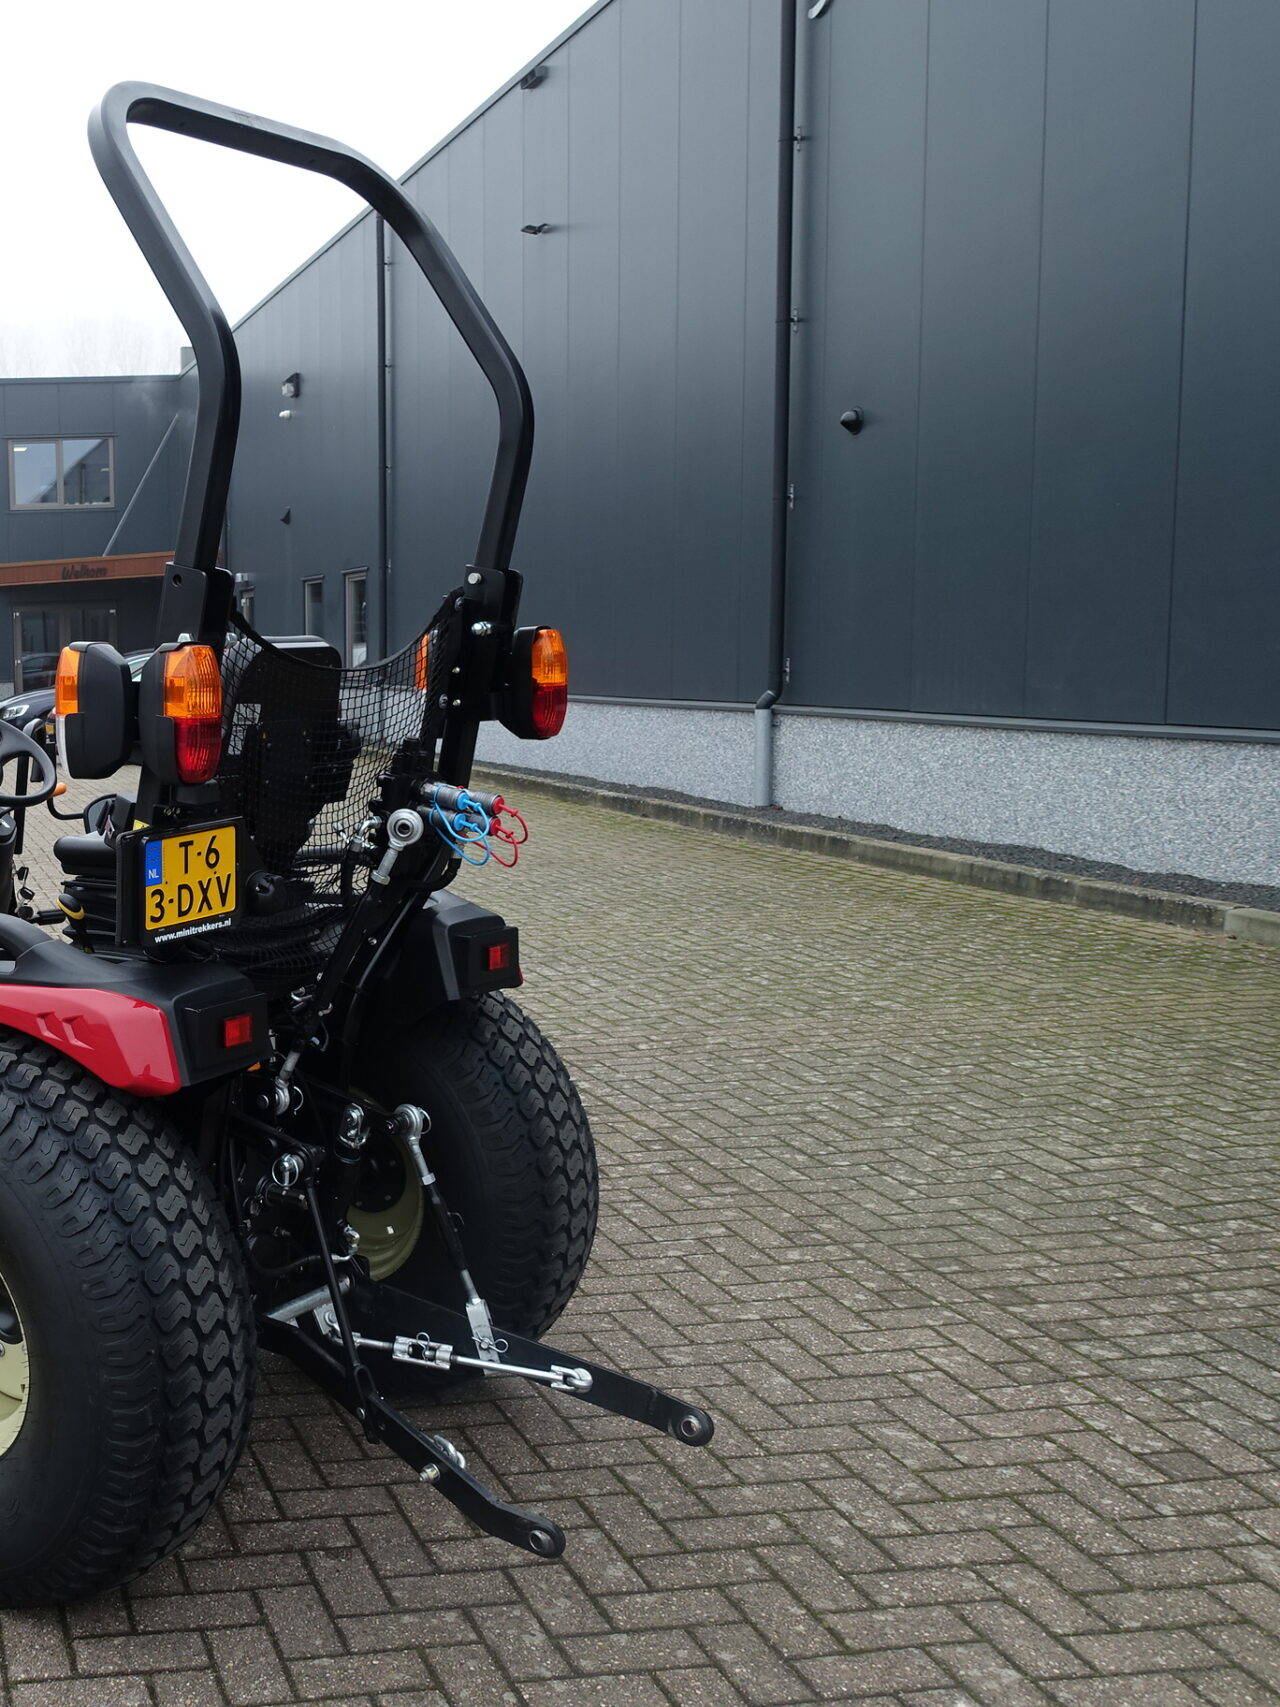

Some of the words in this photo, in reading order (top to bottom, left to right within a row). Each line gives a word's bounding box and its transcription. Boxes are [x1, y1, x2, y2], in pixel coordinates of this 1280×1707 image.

[178, 835, 220, 874] T-6
[148, 868, 159, 879] NL
[150, 873, 231, 923] 3-DXV
[154, 917, 232, 943] www.minitrekkers.nl
